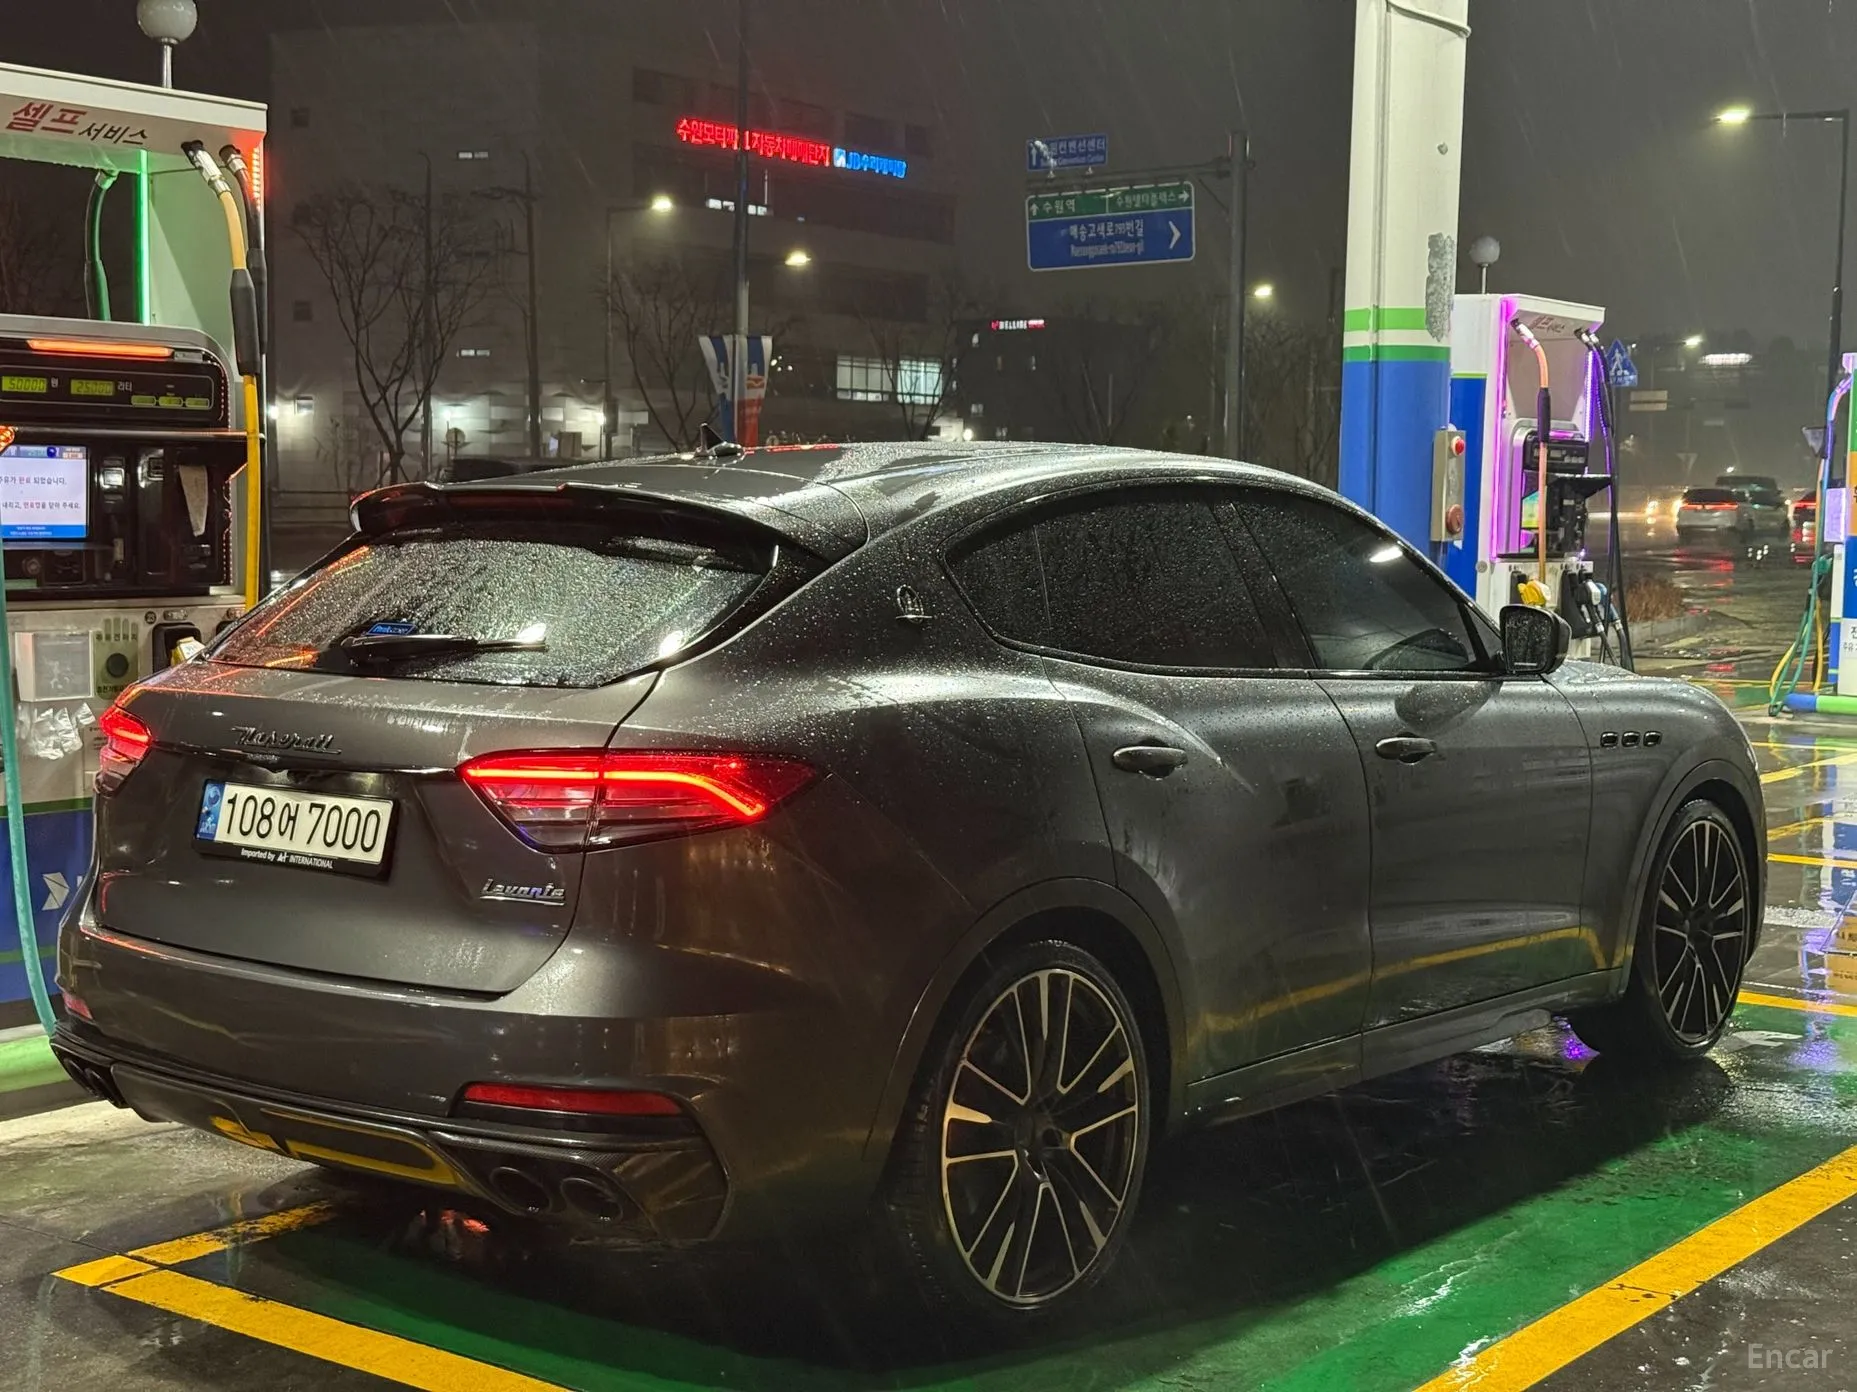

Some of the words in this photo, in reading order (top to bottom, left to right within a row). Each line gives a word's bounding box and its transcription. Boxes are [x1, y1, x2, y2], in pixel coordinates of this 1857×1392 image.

[6, 101, 87, 134] 셀프
[79, 122, 147, 146] 서비스
[1043, 199, 1076, 215] 수원역
[231, 726, 343, 755] Maserati
[226, 791, 297, 842] 108어
[305, 801, 382, 853] 7000
[241, 848, 267, 860] Imported
[267, 850, 276, 862] by
[289, 854, 334, 869] INTERNATIONAL
[480, 877, 566, 905] Levante
